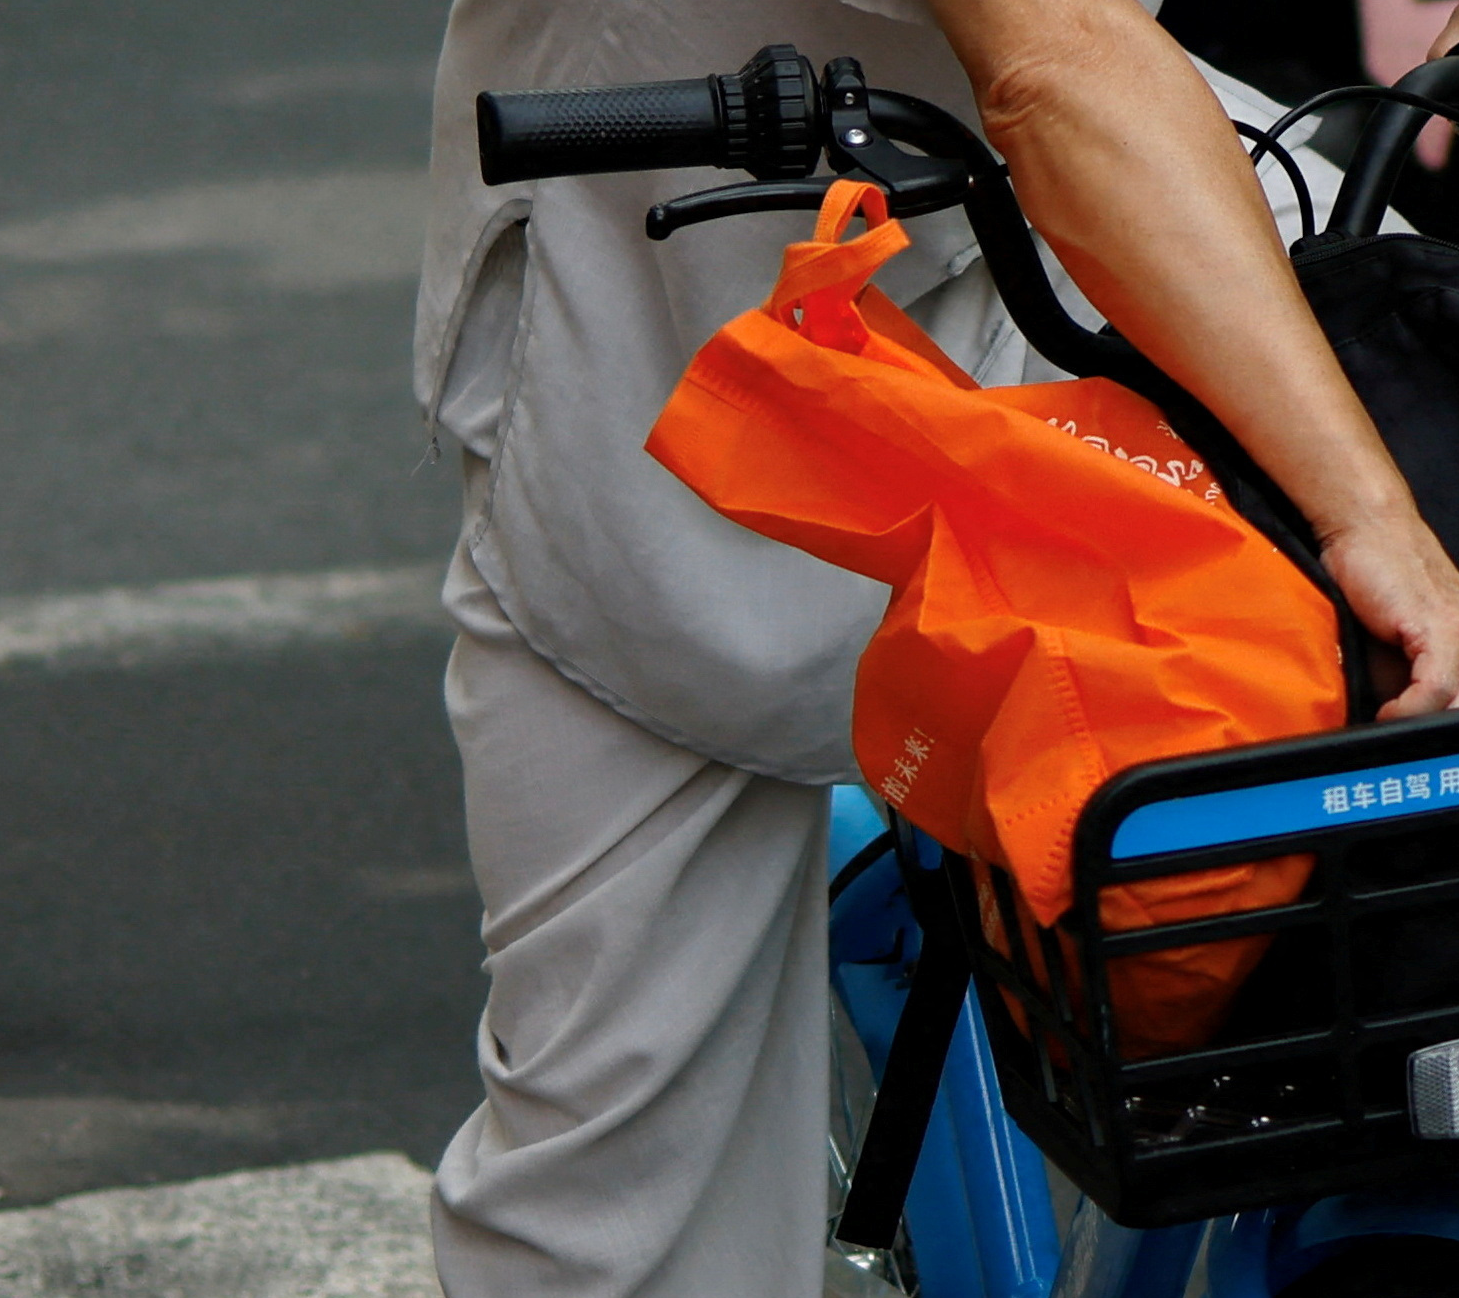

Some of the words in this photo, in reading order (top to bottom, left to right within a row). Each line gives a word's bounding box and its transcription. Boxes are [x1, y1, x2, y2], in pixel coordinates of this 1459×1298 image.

[881, 727, 935, 807] 的未来！
[1321, 772, 1431, 815] 租车自驾
